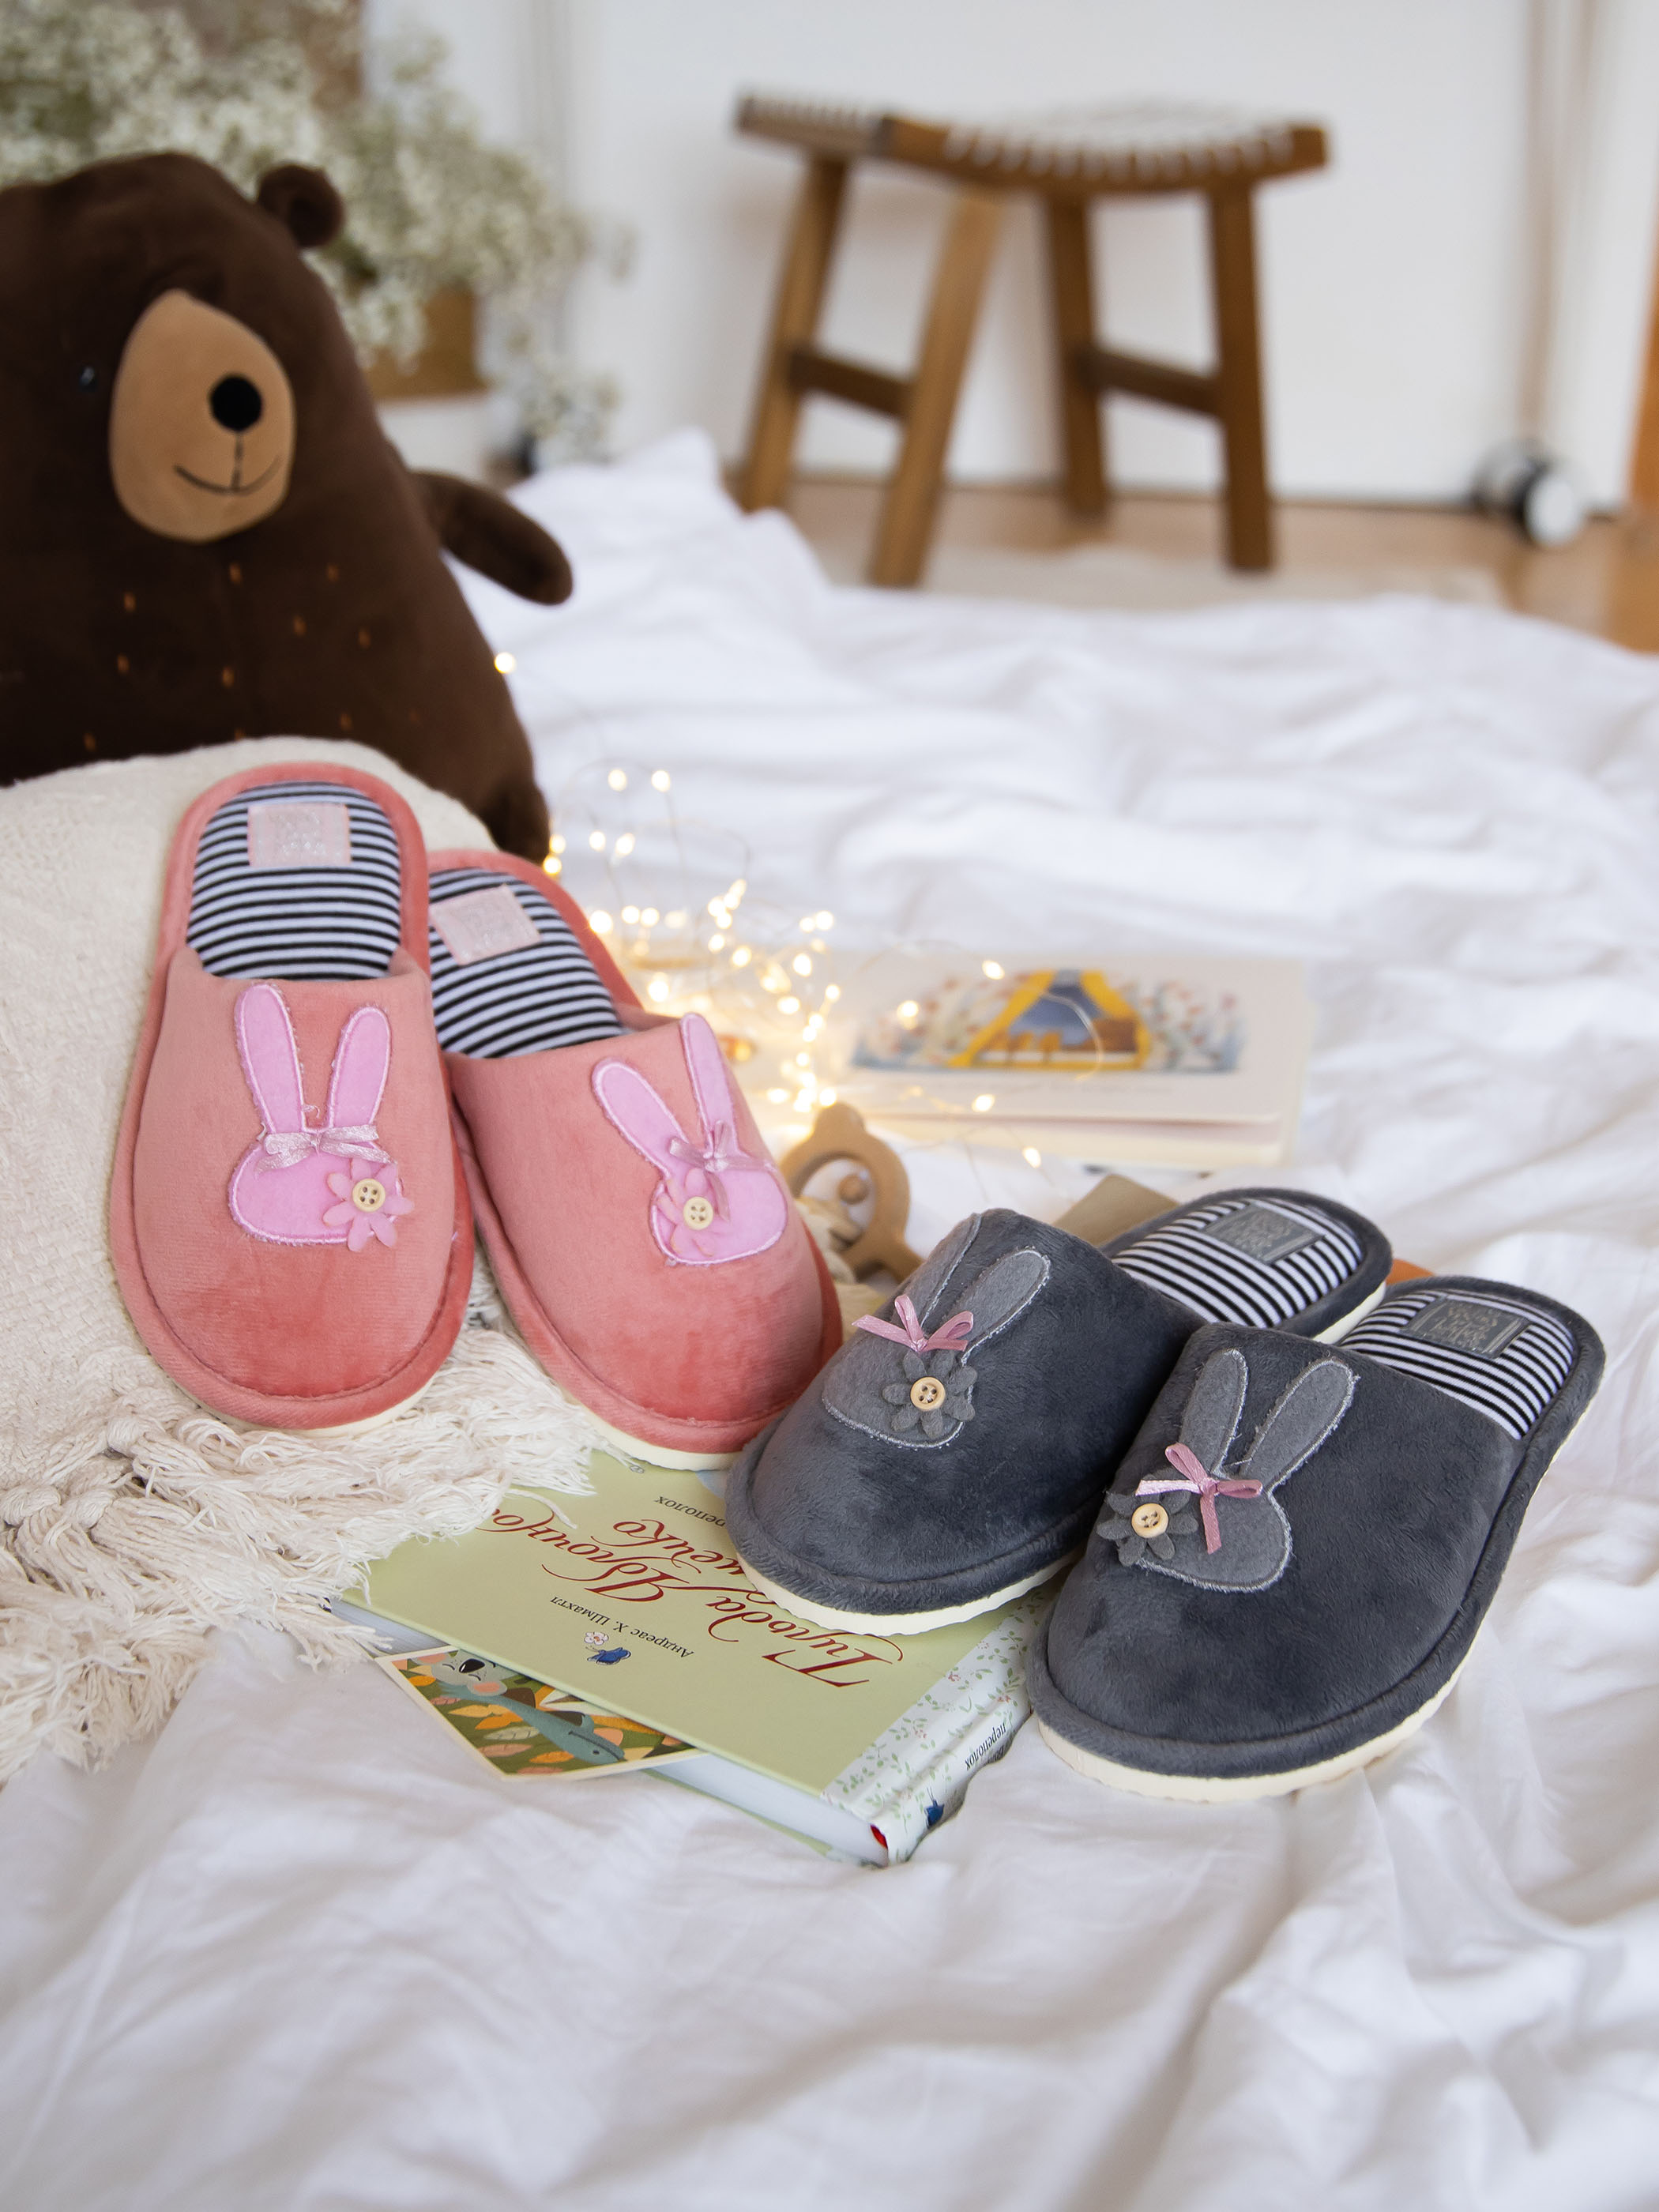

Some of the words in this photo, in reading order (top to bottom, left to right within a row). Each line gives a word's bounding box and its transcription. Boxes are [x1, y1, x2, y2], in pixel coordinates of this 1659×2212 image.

[654, 1496, 726, 1527] реполох
[475, 1508, 766, 1602] Яблочно
[549, 1596, 611, 1627] Шмахтл
[612, 1620, 629, 1634] Х.
[630, 1628, 695, 1659] Андреас
[705, 1596, 903, 1687] Тильда
[965, 1722, 1006, 1771] переполох
